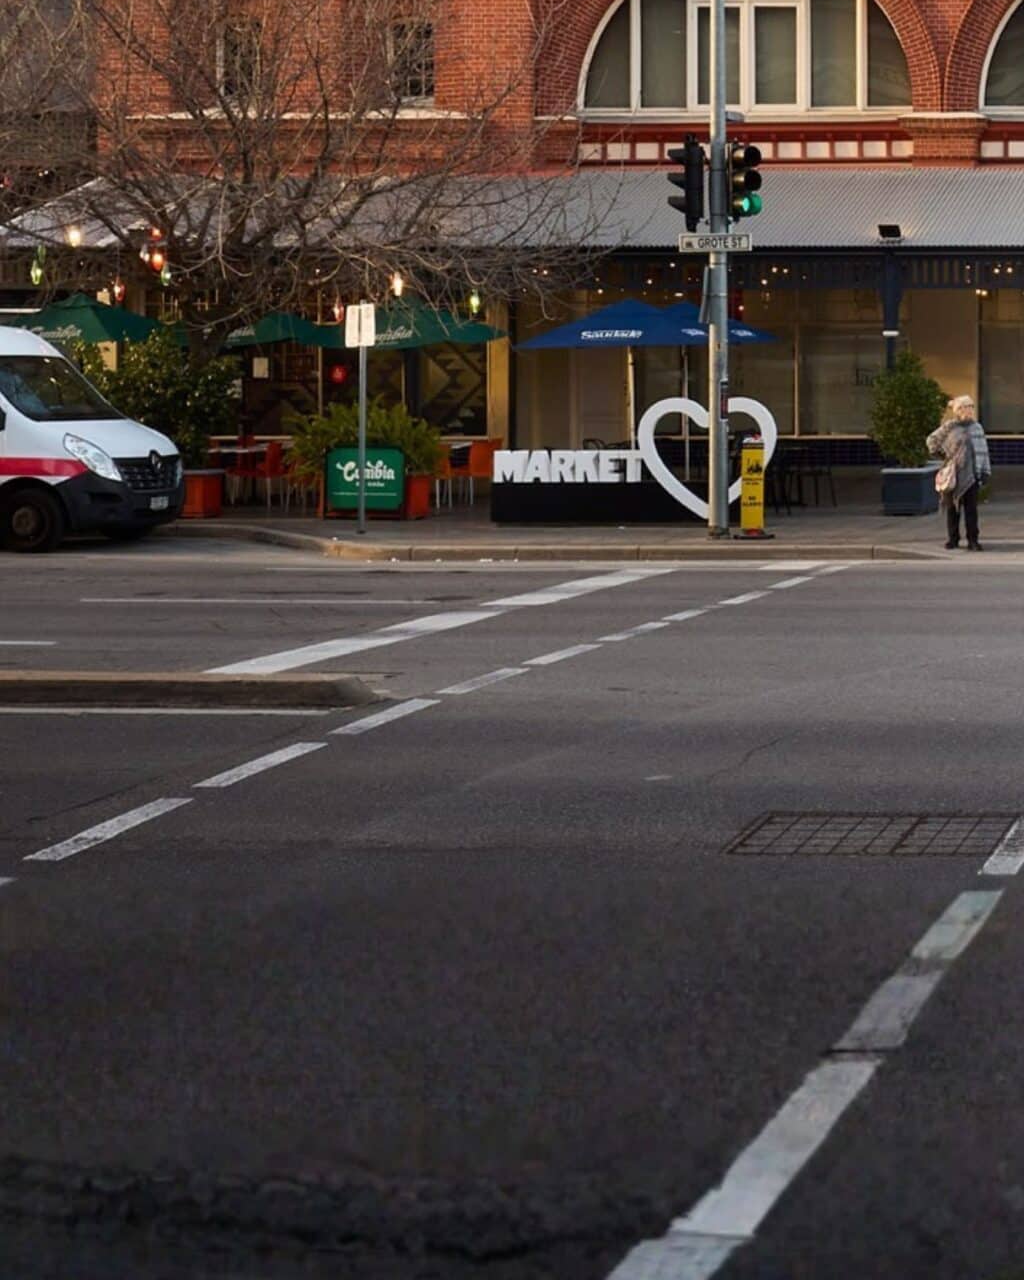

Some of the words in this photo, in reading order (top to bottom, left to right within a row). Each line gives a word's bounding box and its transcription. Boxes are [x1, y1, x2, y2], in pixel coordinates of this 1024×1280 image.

[697, 236, 729, 249] GROTE
[731, 236, 743, 248] ST
[493, 450, 642, 483] MARKET
